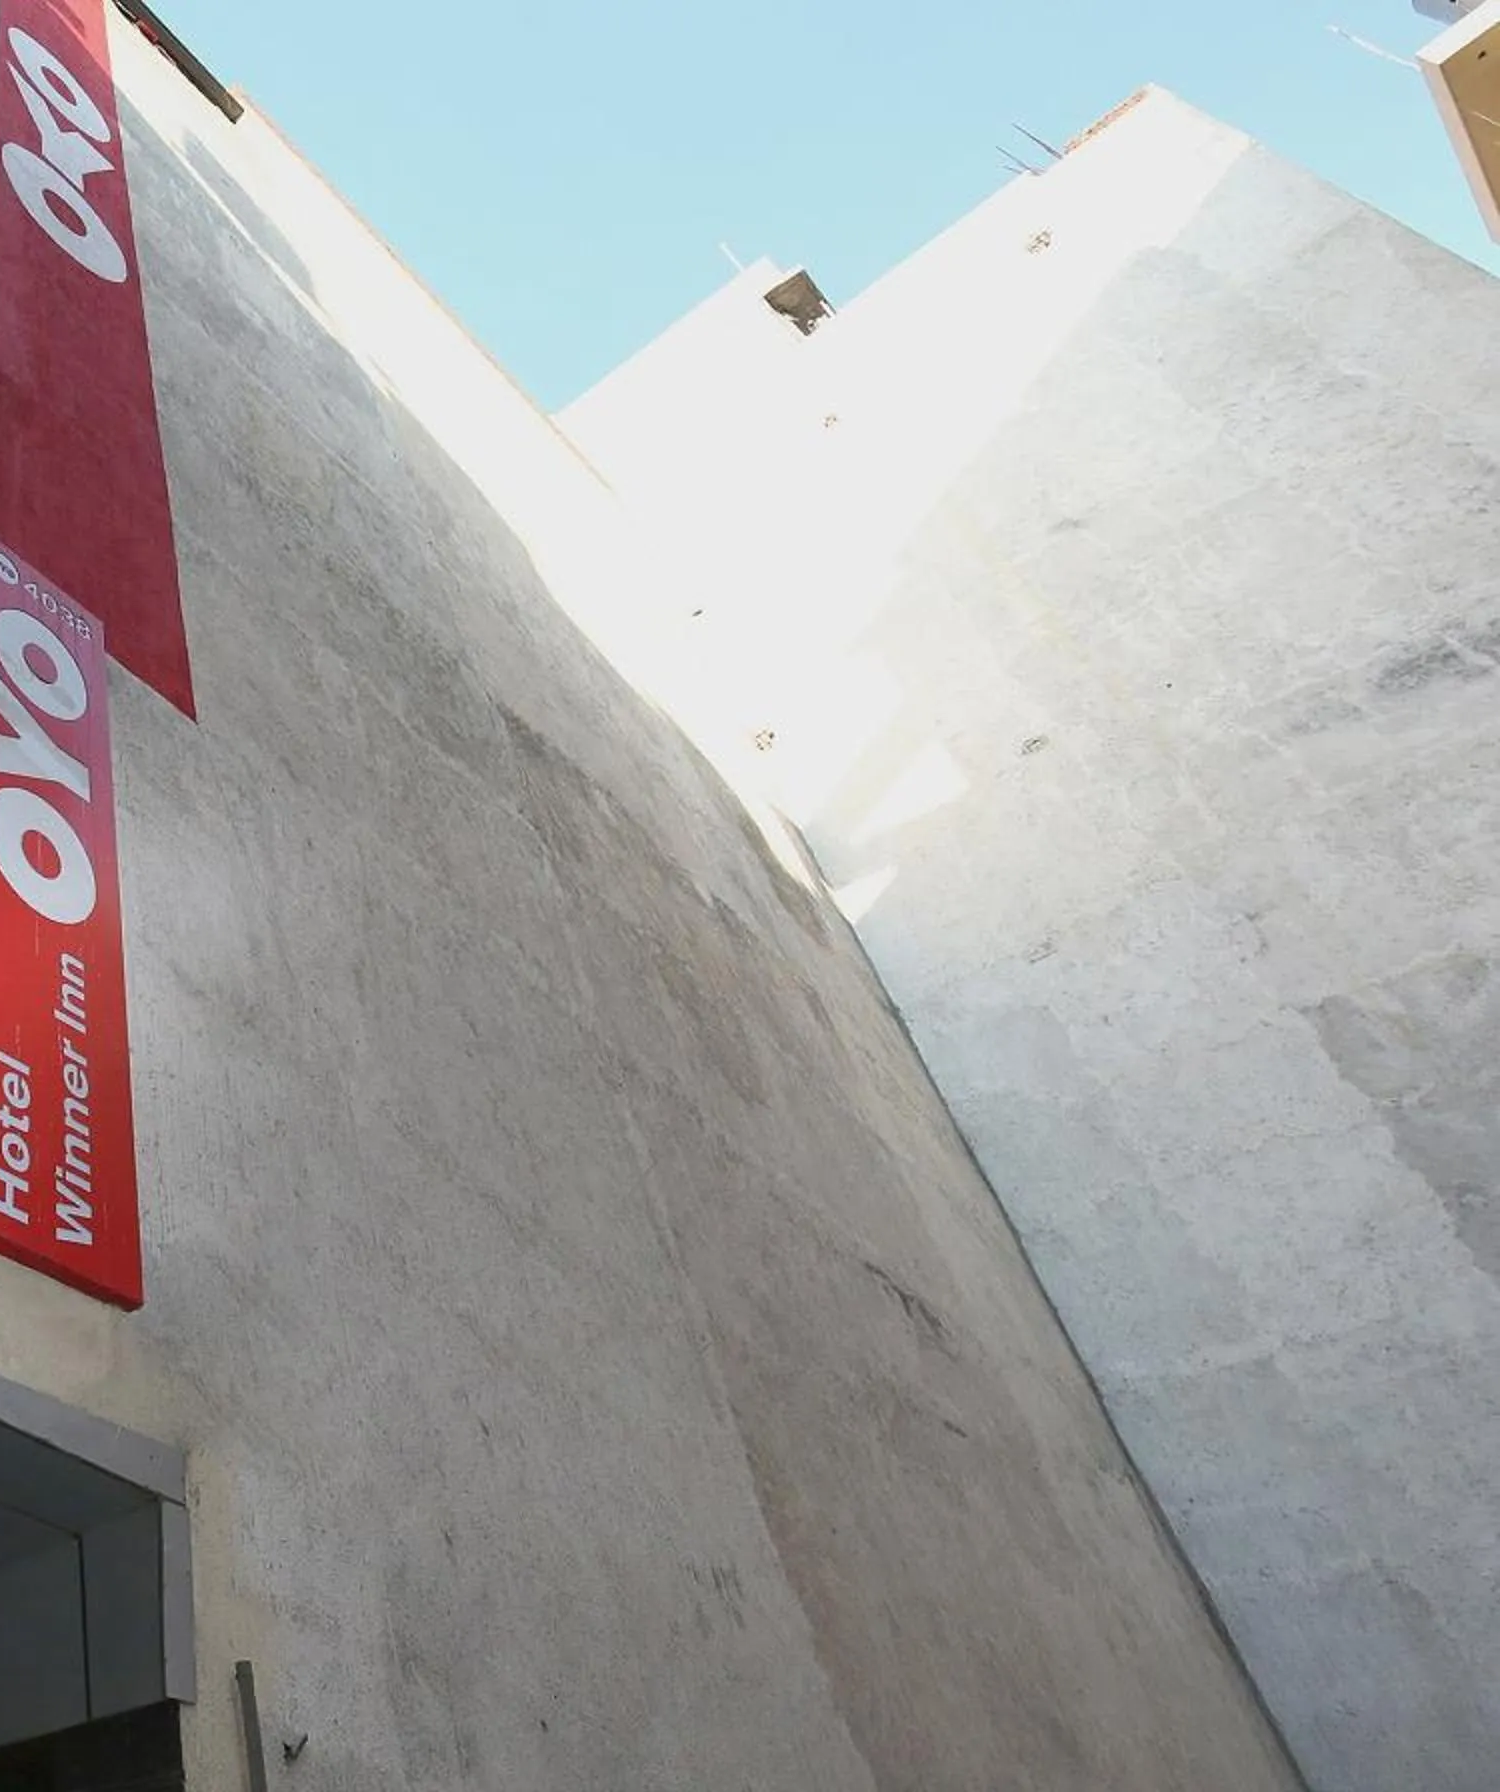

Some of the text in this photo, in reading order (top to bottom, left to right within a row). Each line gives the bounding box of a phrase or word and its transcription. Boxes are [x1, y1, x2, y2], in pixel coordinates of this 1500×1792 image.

[1, 27, 127, 283] OYO
[53, 952, 93, 1246] Winner Inn
